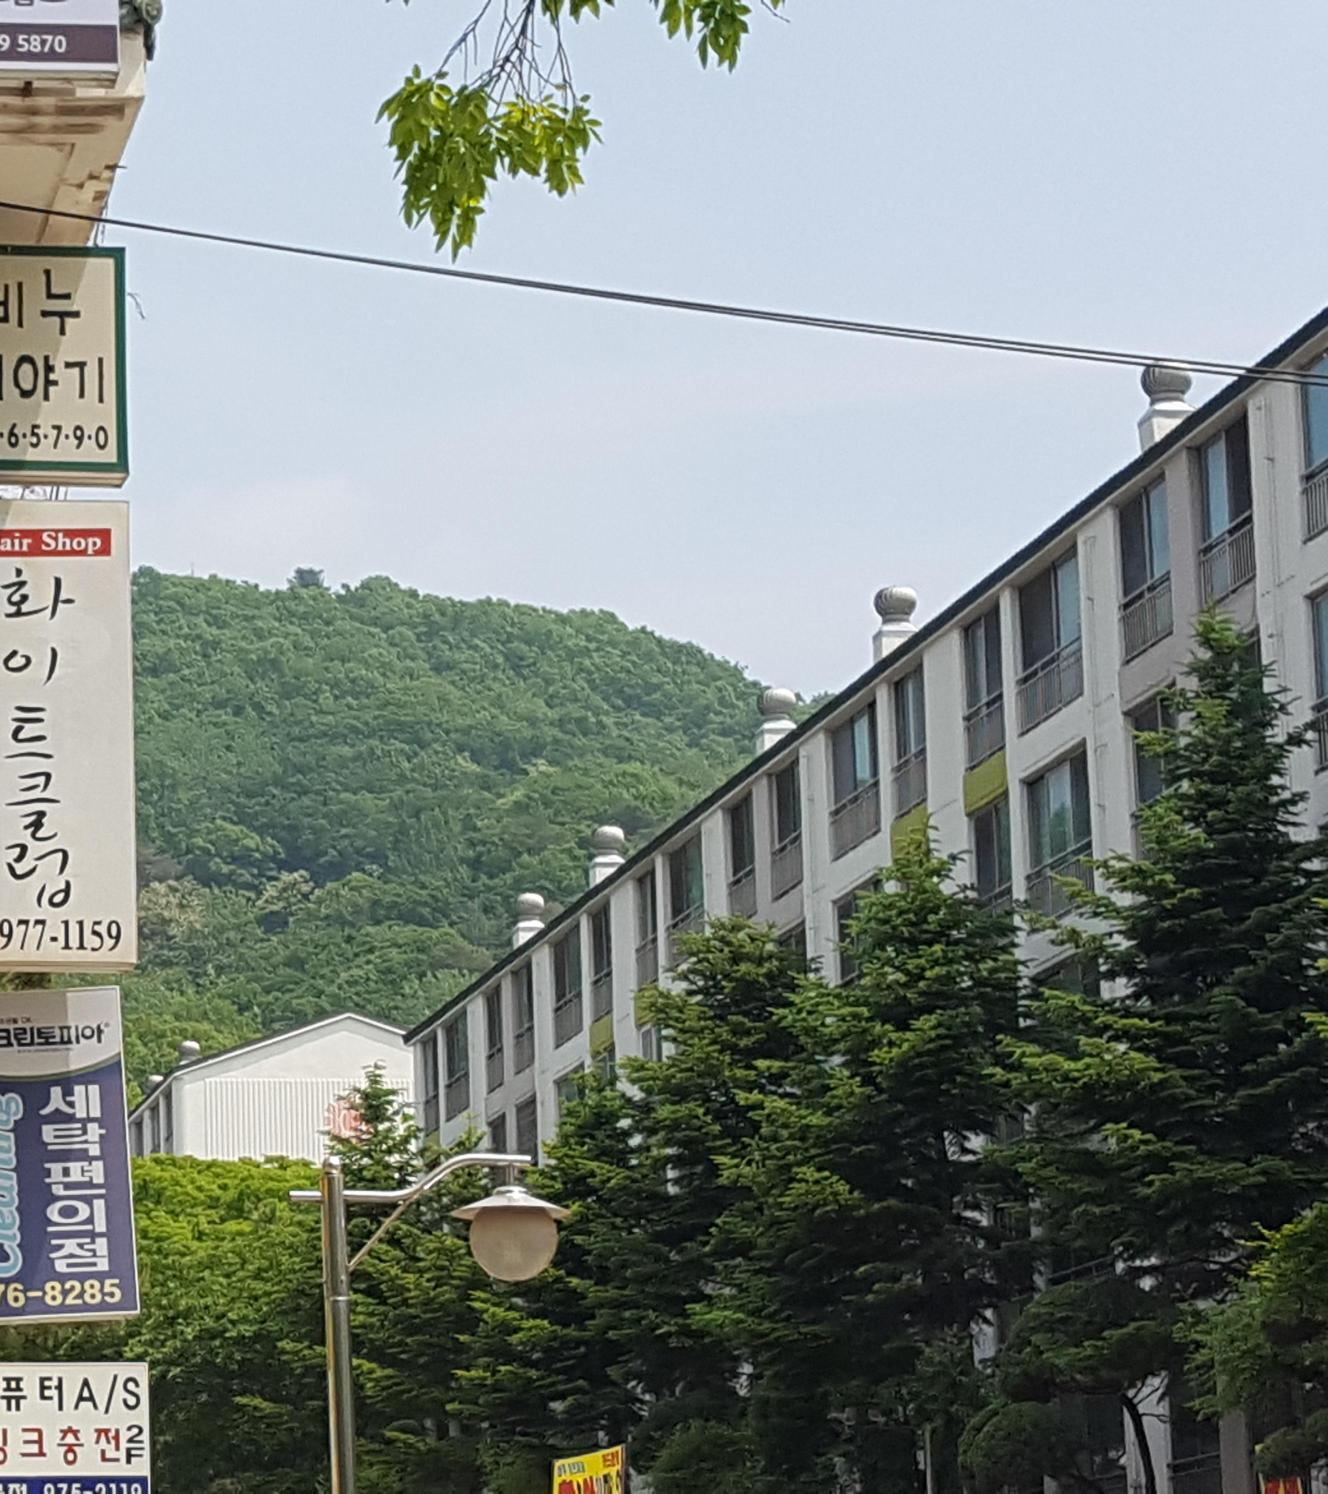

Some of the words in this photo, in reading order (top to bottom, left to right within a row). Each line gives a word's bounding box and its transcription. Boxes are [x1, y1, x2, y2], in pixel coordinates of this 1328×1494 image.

[17, 34, 67, 54] 5870
[40, 532, 102, 556] Shop
[38, 1084, 110, 1274] 세탁편의점
[125, 1424, 145, 1465] 2F
